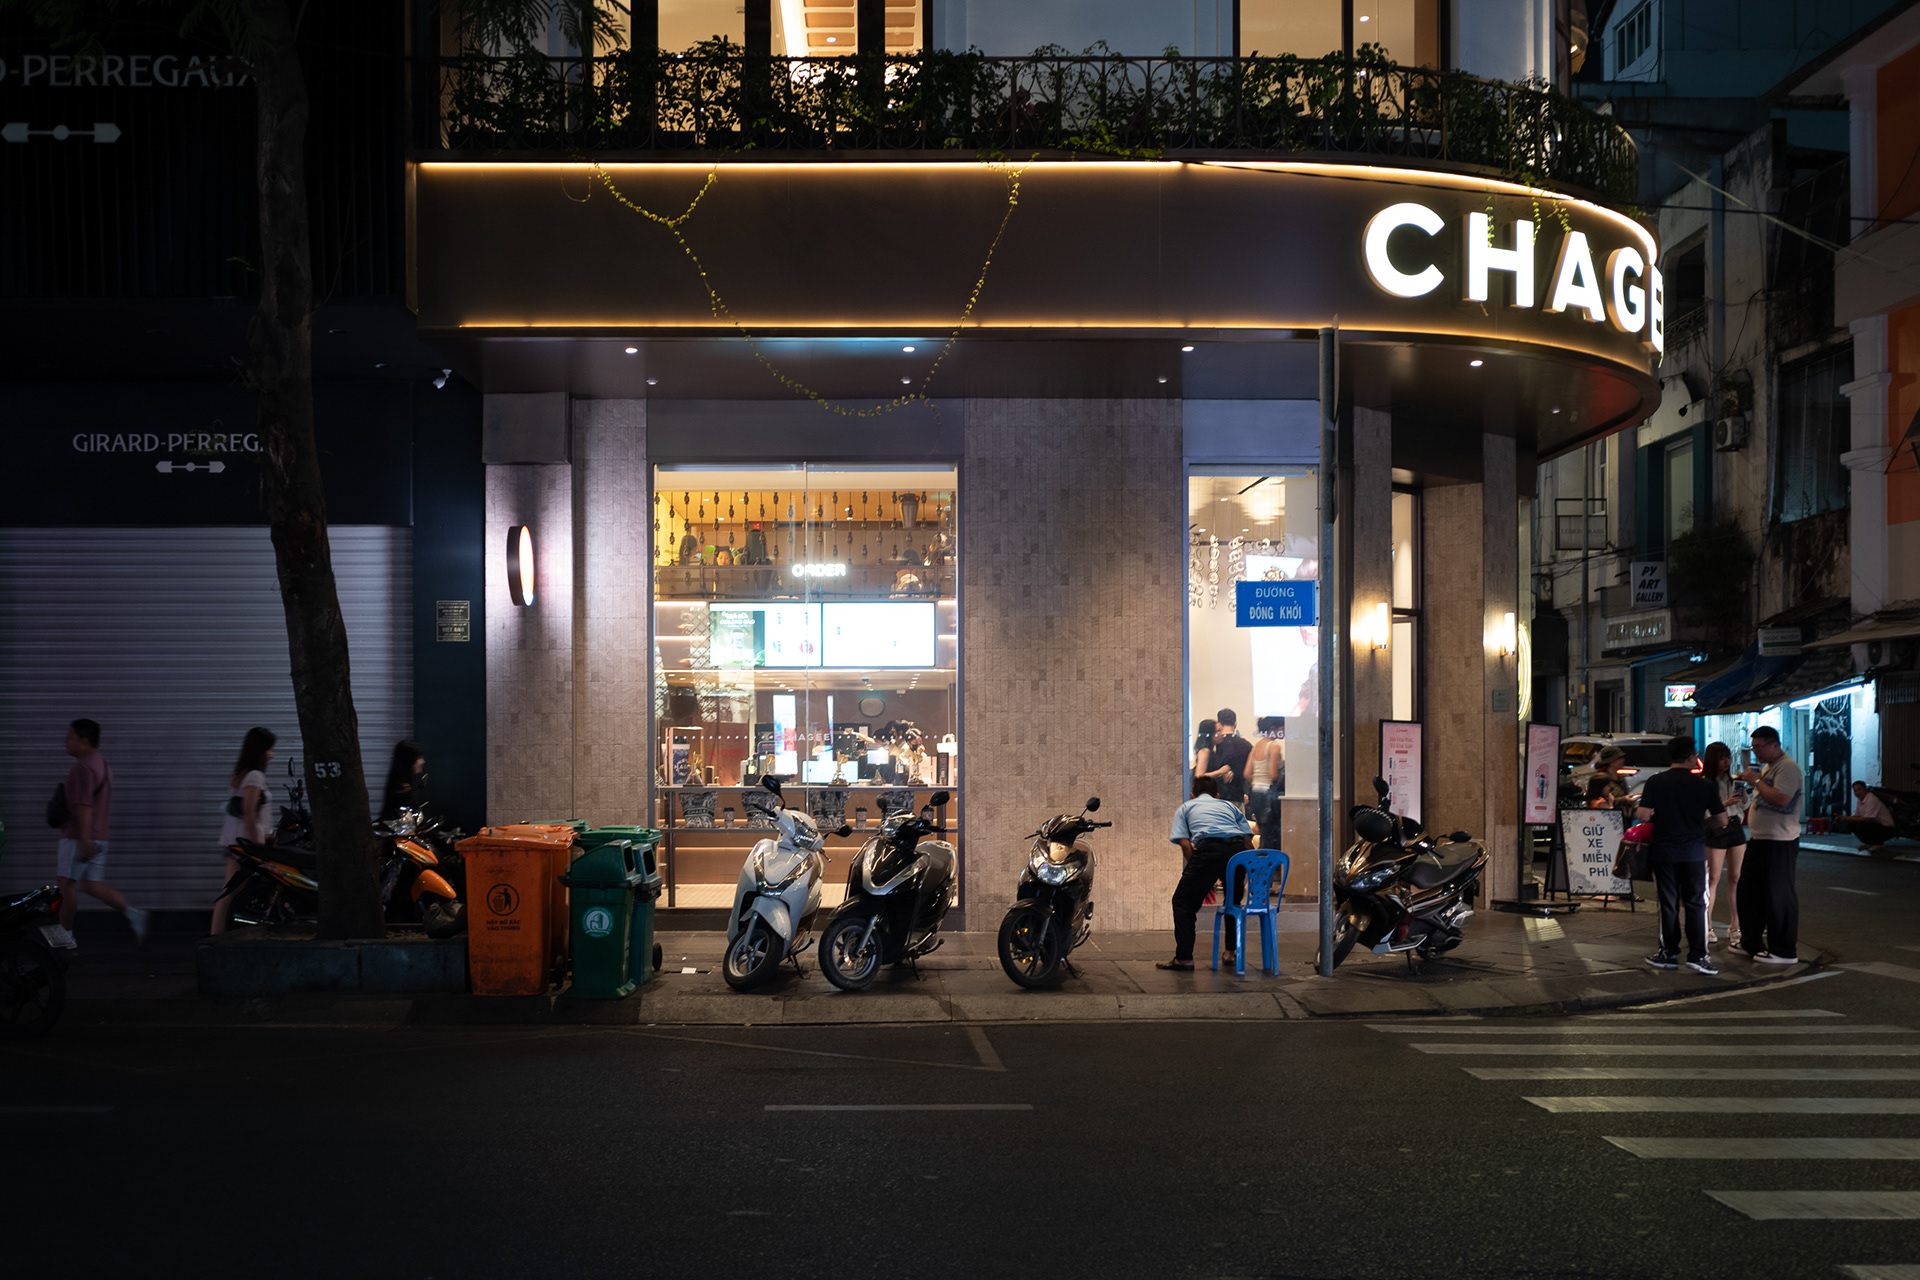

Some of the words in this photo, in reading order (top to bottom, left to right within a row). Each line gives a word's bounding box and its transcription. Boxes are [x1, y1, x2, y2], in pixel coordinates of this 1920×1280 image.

[72, 433, 263, 452] GIRARD-PERREG
[792, 563, 847, 577] ORDER
[1641, 565, 1658, 577] PY
[1638, 579, 1661, 590] ART
[1636, 591, 1665, 603] GALLERY
[314, 761, 342, 779] 53
[1587, 838, 1604, 849] XE
[1589, 864, 1609, 877] PHÍ
